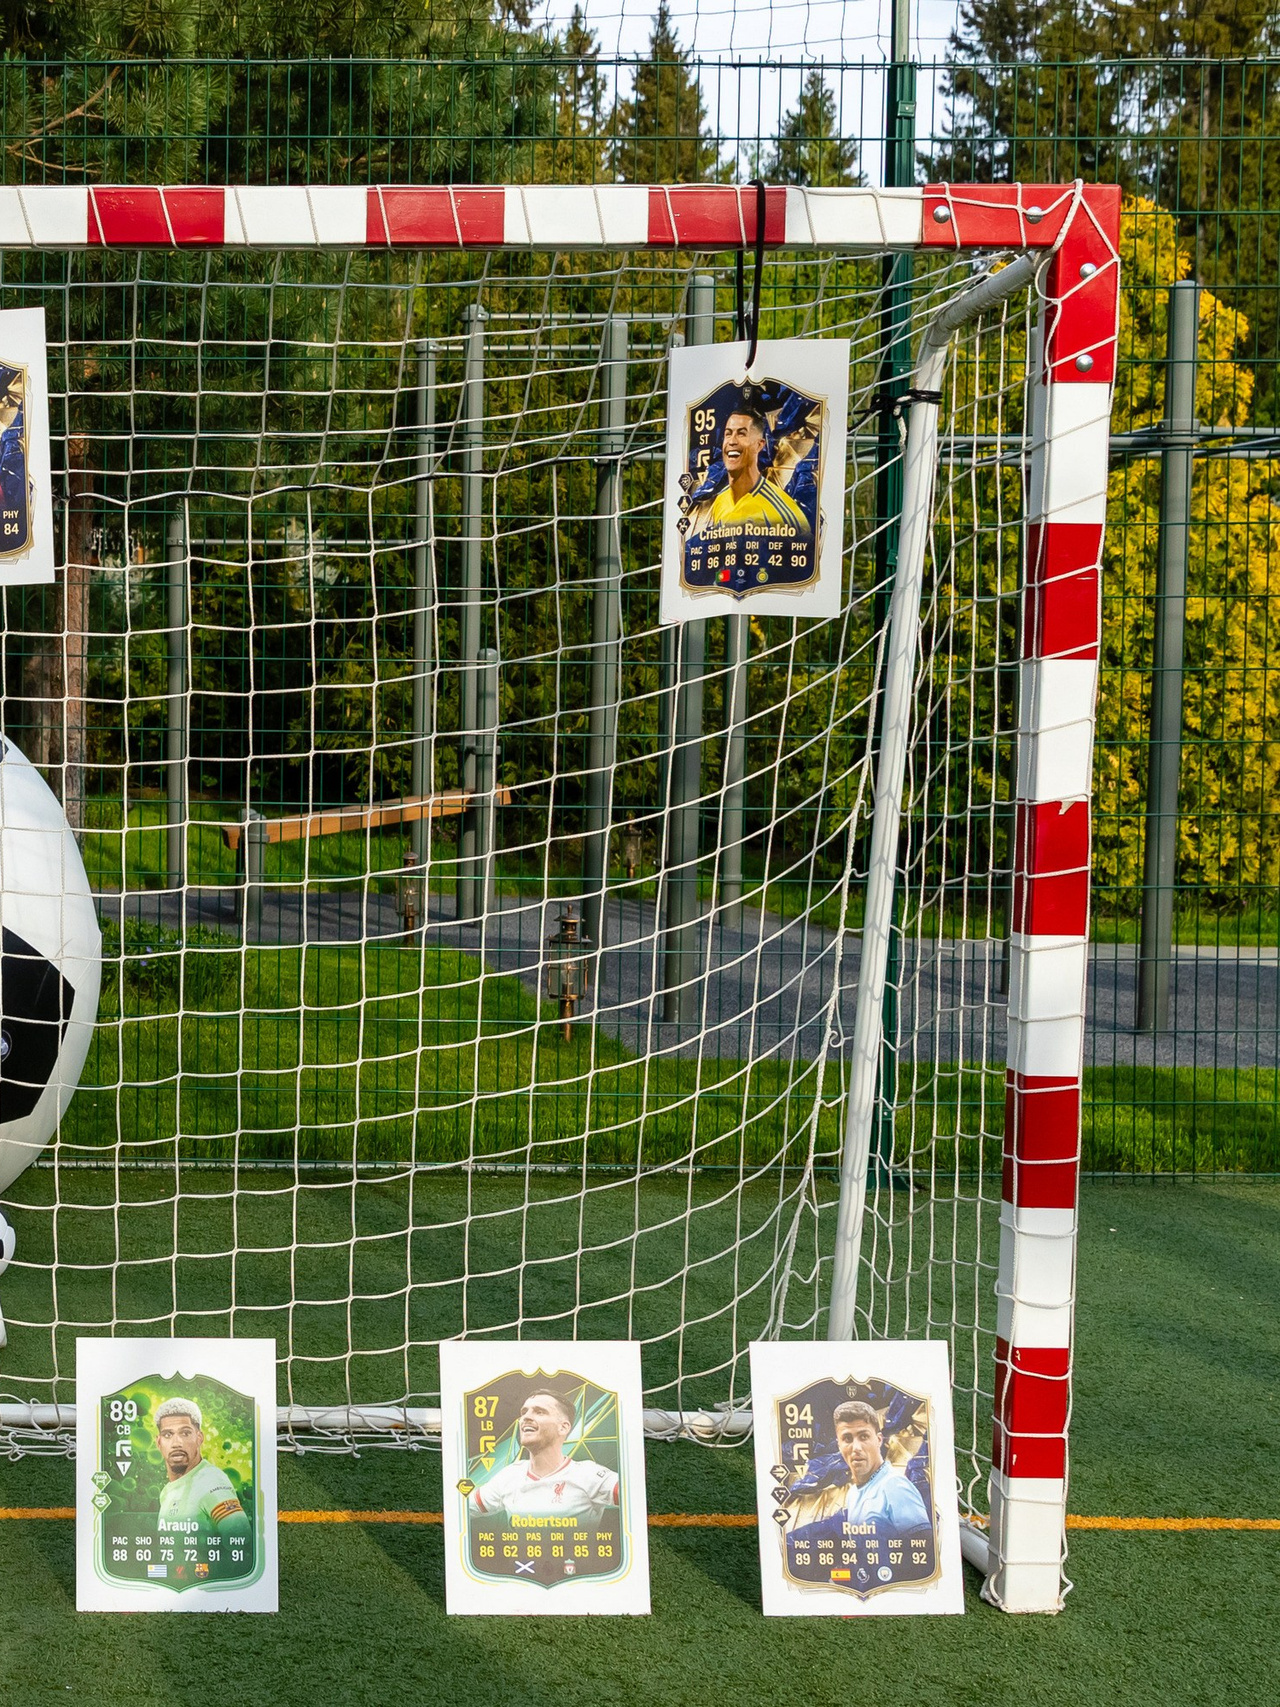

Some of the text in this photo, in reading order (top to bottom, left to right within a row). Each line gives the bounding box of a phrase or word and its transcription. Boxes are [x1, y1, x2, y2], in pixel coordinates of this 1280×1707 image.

[695, 408, 715, 432] 95
[699, 433, 709, 445] ST
[3, 510, 19, 519] PHY
[4, 522, 19, 534] 84
[699, 523, 796, 540] Cristiano Ronaldo
[691, 540, 807, 555] PAC SHO PAS DRI DEF PHY
[691, 553, 806, 571] 91 96 88 92 42 90
[110, 1400, 137, 1422] 89
[474, 1396, 499, 1418] 87
[785, 1404, 813, 1425] 94
[116, 1424, 131, 1435] CB
[481, 1421, 493, 1431] LB
[788, 1428, 812, 1439] CDM
[158, 1519, 199, 1533] Araujo
[512, 1515, 577, 1528] Robertson
[843, 1522, 876, 1535] Rodri
[112, 1536, 245, 1545] PAC SHO PAS DRI DEF PHY
[479, 1532, 612, 1541] PAC SHO PAS DRI DEF PHY
[795, 1539, 926, 1549] PAC SHO PAS DRI DEF PHY
[113, 1550, 243, 1561] 88 60 75 72 91 91
[479, 1546, 612, 1557] 86 62 86 81 85 83
[796, 1553, 927, 1565] 89 86 94 91 97 92
